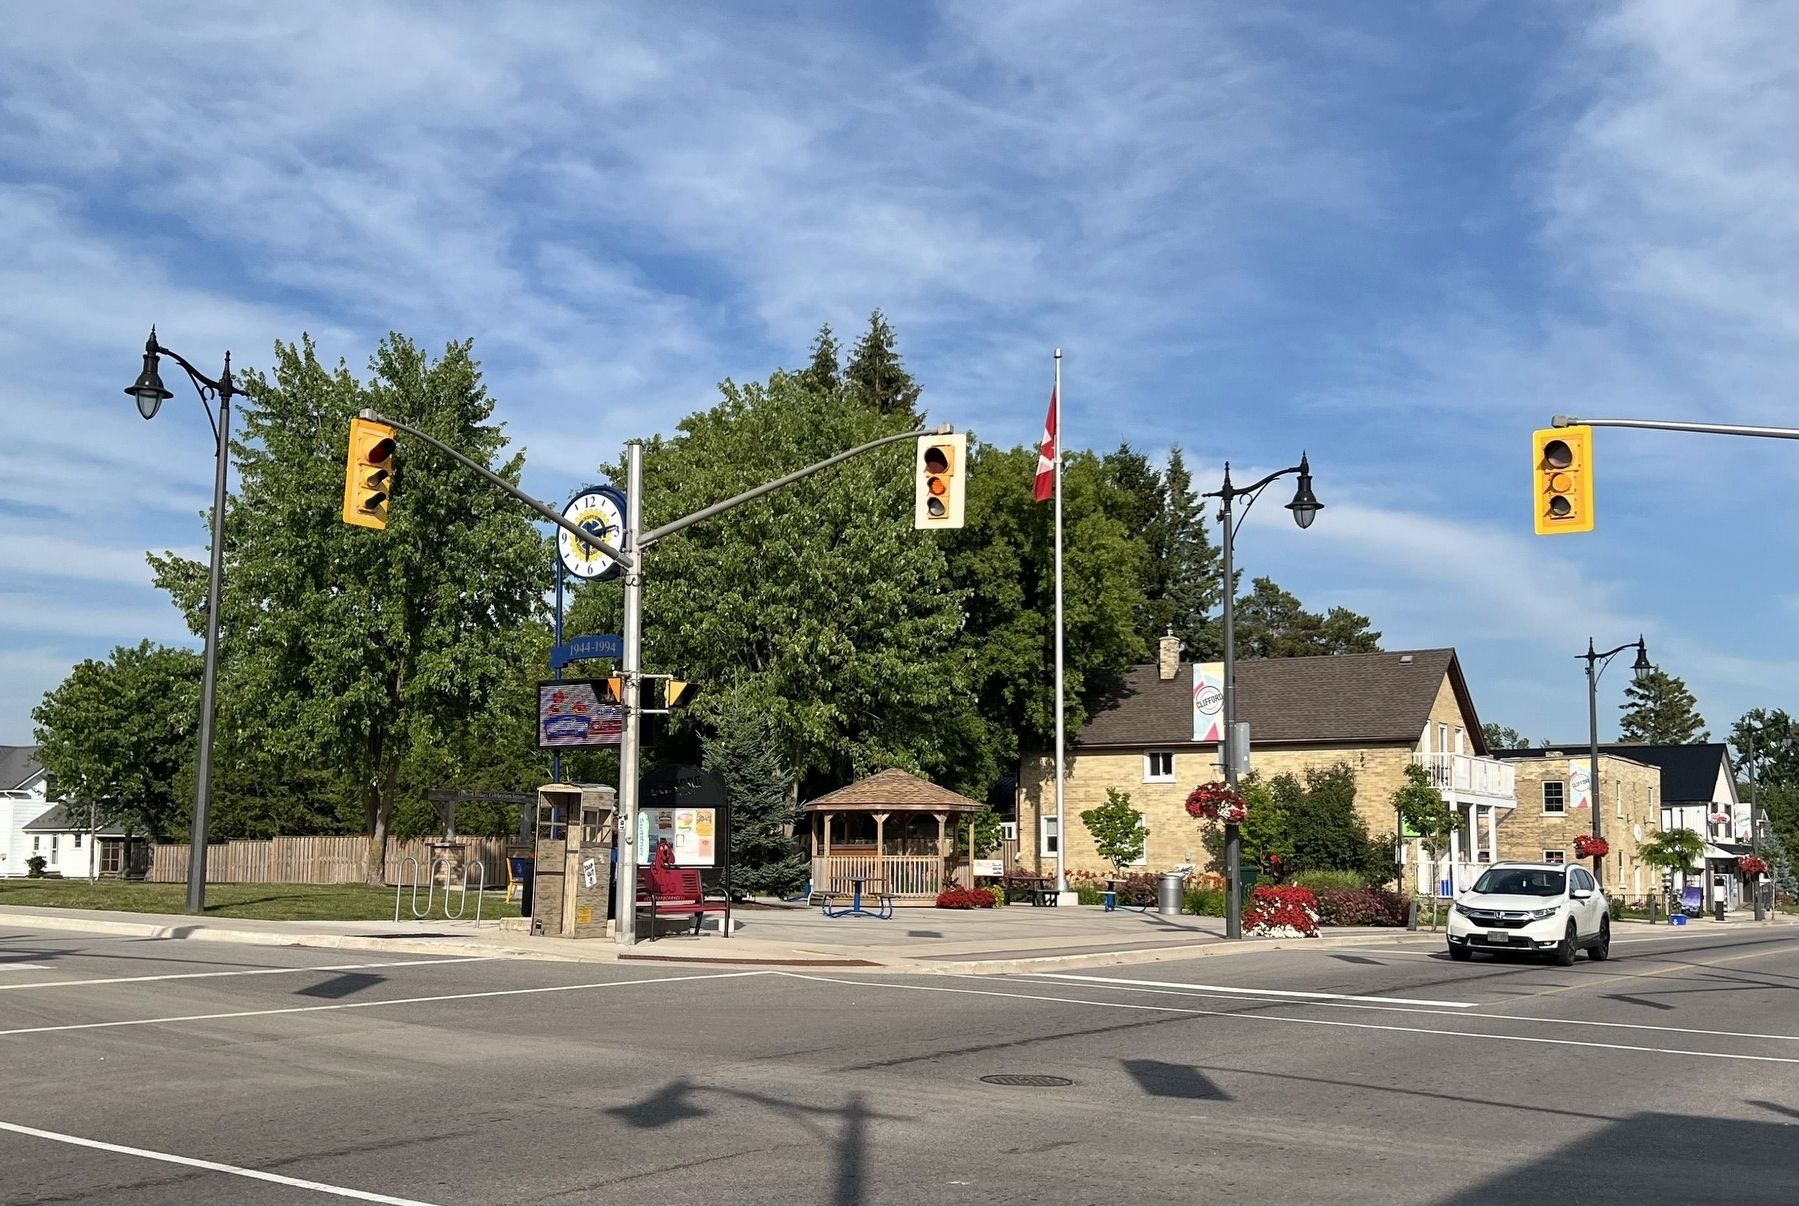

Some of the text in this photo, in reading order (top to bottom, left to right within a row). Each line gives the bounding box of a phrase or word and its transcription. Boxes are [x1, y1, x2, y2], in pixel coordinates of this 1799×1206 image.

[585, 496, 596, 508] 12
[613, 525, 620, 537] 3
[561, 533, 568, 544] 9
[587, 564, 593, 575] 6
[570, 641, 616, 656] 1944-1994
[1196, 693, 1224, 708] CLIFFORD
